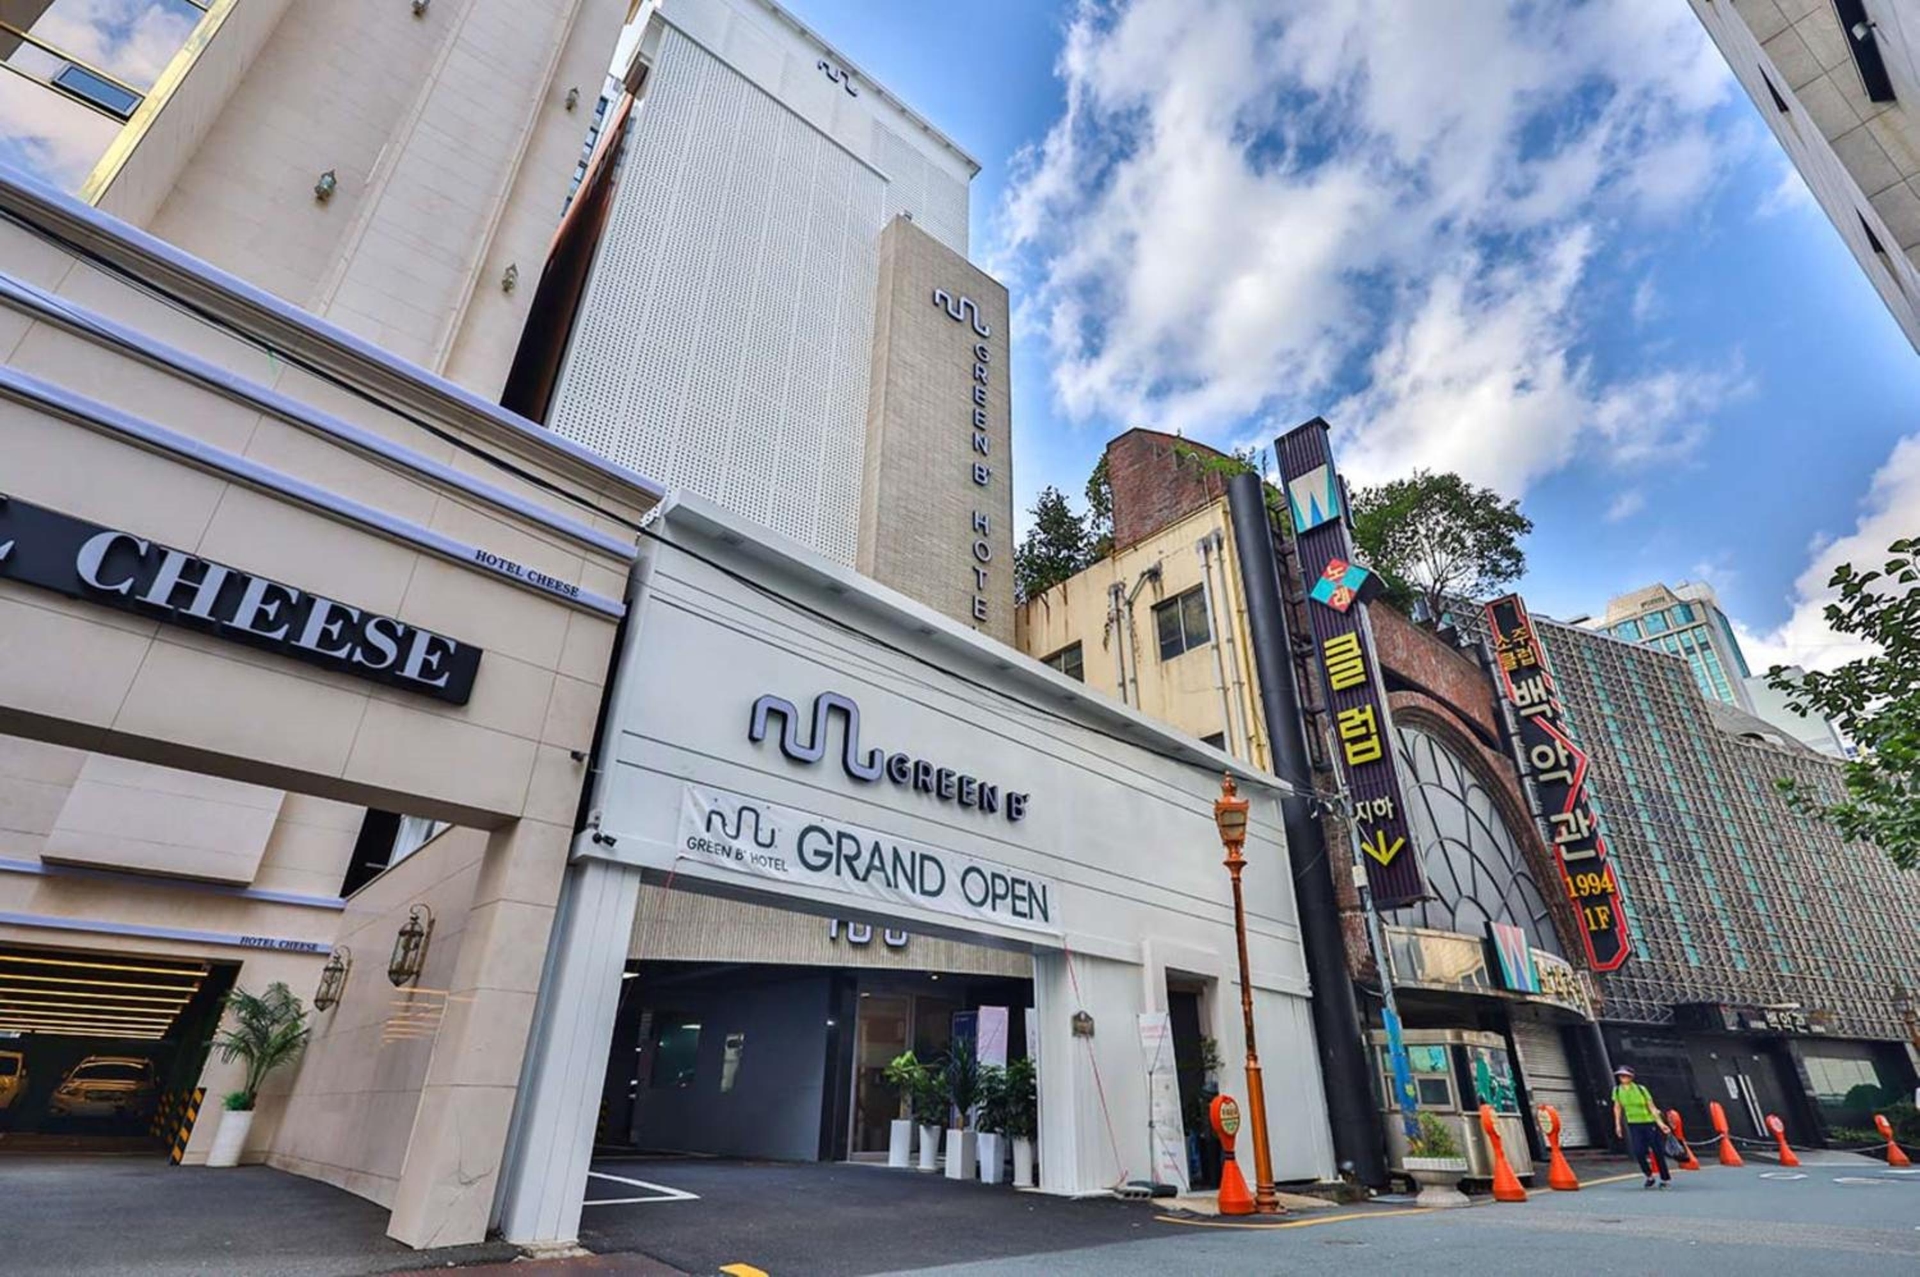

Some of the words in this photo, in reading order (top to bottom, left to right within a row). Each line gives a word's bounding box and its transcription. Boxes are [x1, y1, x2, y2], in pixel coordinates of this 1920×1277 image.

[973, 344, 991, 456] GREEN
[475, 549, 522, 577] HOTEL
[527, 569, 580, 598] CHEESE
[973, 511, 992, 629] HOTE
[77, 530, 458, 688] CHEESE
[1324, 631, 1383, 766] 클럽
[886, 752, 1000, 814] GREEN
[1511, 674, 1596, 862] 백악관
[1355, 796, 1394, 824] 지하
[686, 835, 732, 858] GREEN
[750, 852, 789, 872] HOTEL
[796, 823, 946, 898] GRAND
[960, 865, 1050, 923] OPEN
[1564, 872, 1615, 898] 1994
[240, 936, 275, 947] HOTEL
[278, 940, 319, 951] CHEESE
[1584, 905, 1610, 931] 1F
